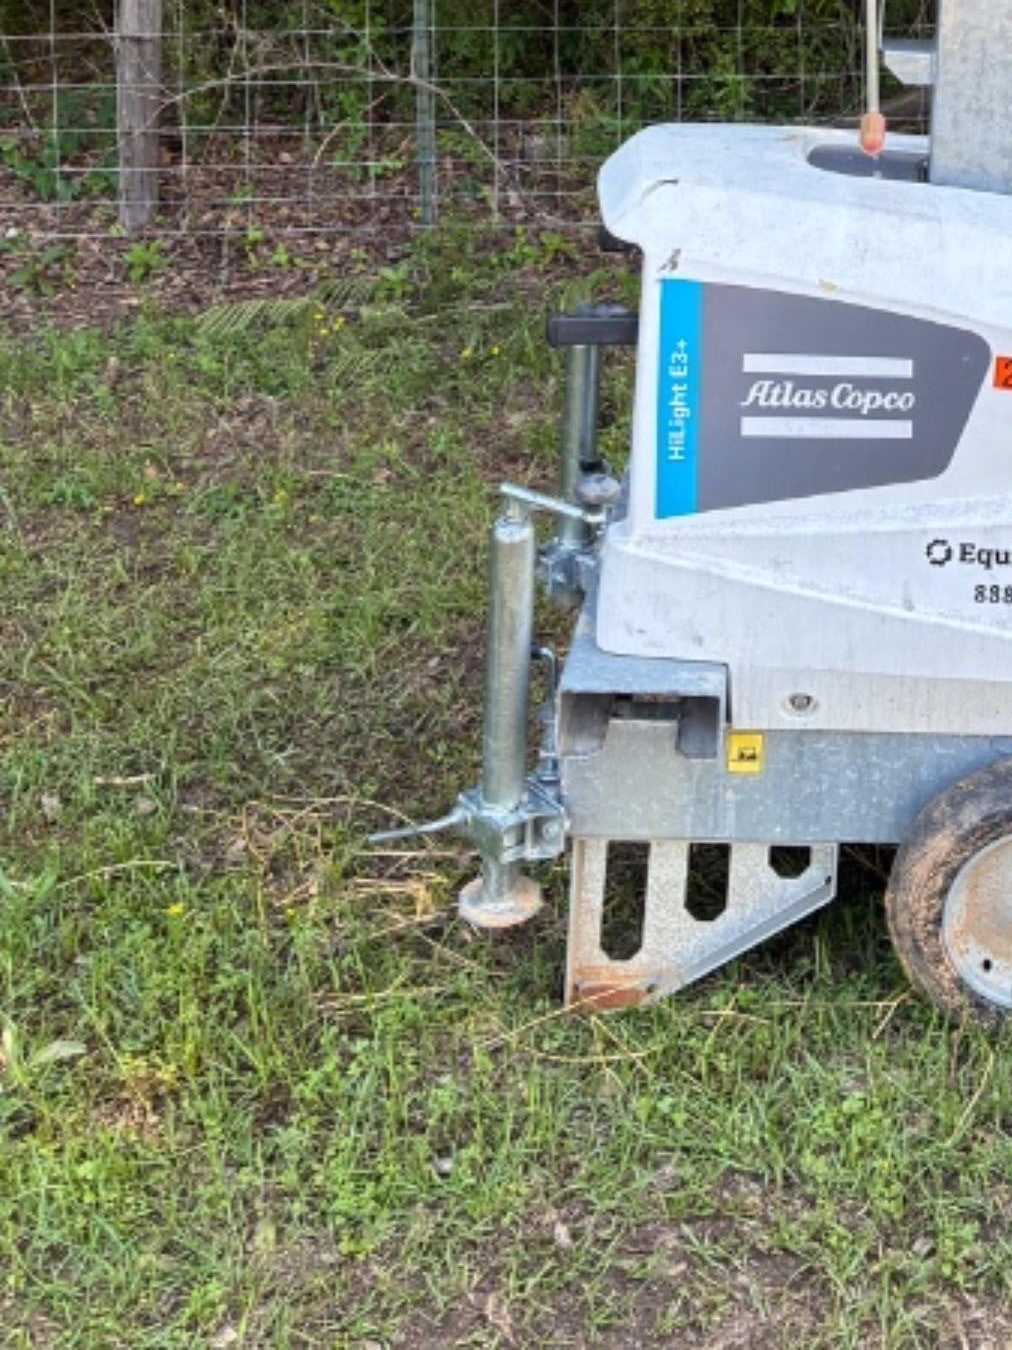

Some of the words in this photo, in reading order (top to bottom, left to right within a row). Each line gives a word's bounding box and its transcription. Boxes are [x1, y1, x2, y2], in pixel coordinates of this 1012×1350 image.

[668, 338, 688, 378] E3+
[740, 380, 828, 408] Atlas
[830, 383, 916, 415] Copco
[667, 383, 691, 460] HiLight
